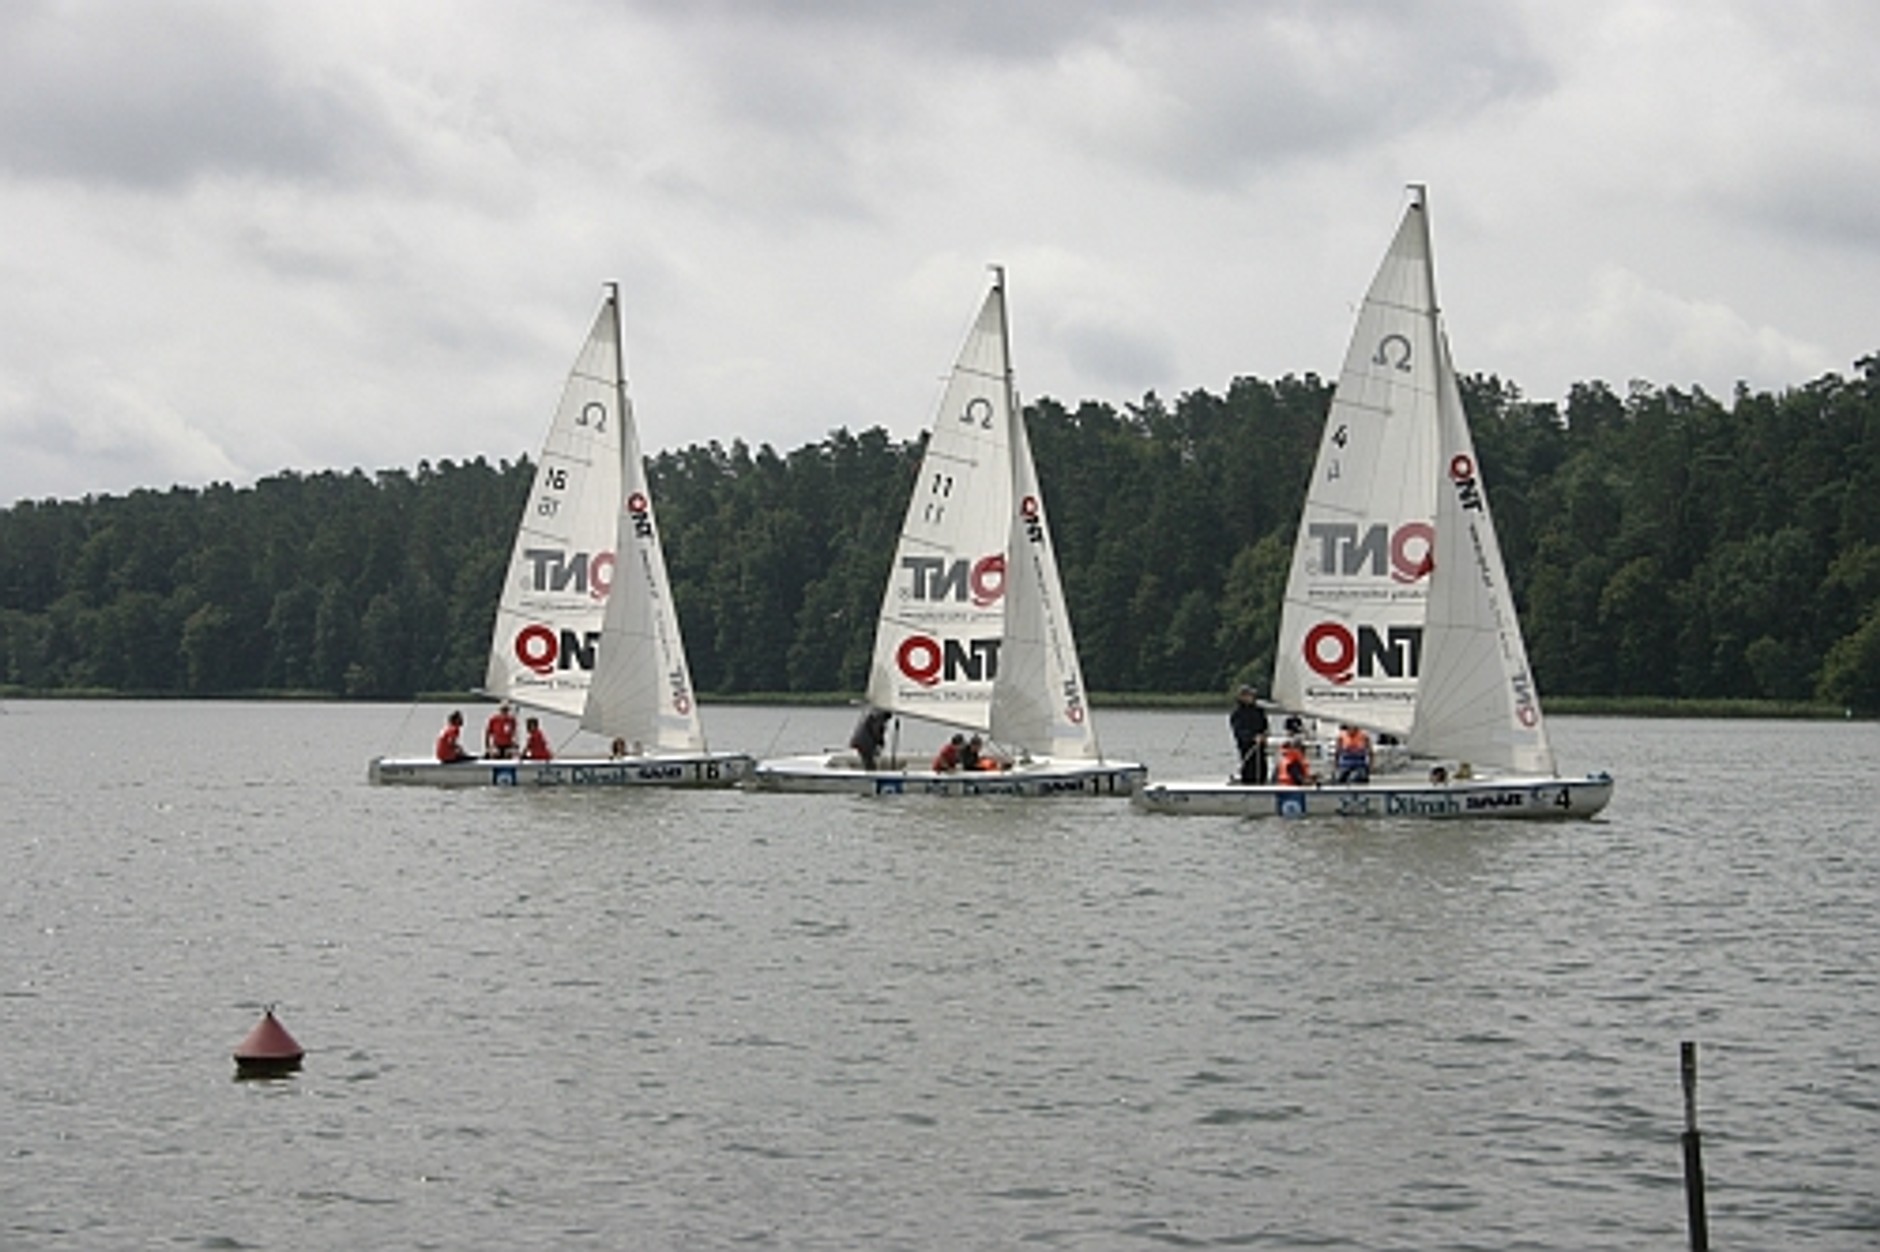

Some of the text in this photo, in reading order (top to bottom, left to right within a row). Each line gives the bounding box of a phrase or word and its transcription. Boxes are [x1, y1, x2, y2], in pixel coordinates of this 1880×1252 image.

[1331, 424, 1347, 449] 4
[545, 466, 569, 490] 16
[931, 473, 953, 498] 11
[896, 635, 1002, 688] QNT
[1303, 622, 1423, 685] QNT
[694, 761, 719, 780] 16
[1091, 774, 1115, 797] 11
[1386, 792, 1460, 815] Dilmah
[1555, 786, 1571, 810] 4
